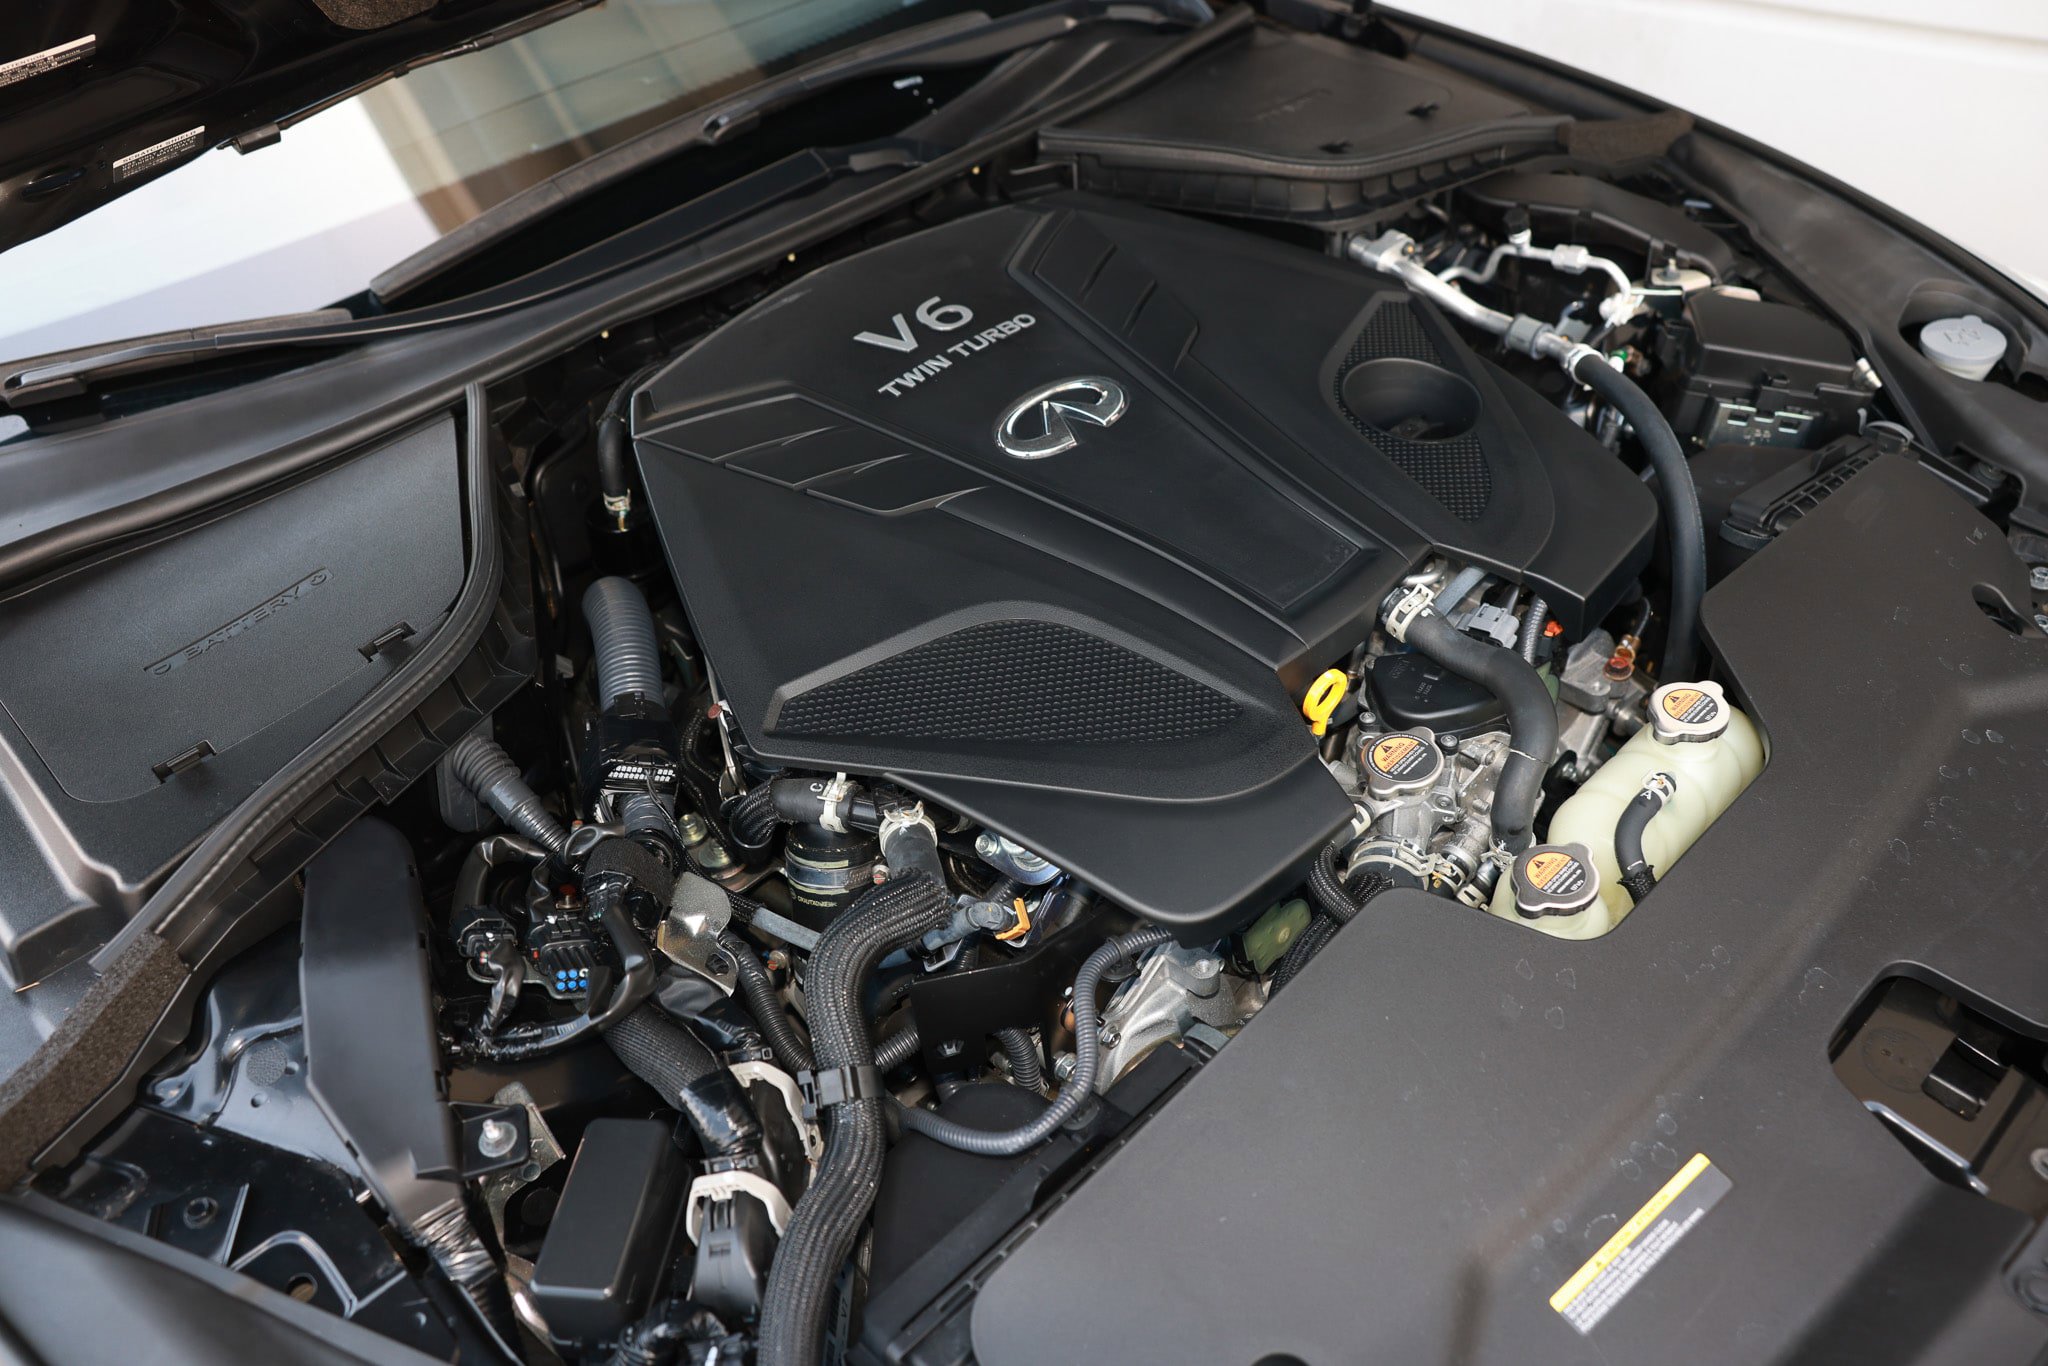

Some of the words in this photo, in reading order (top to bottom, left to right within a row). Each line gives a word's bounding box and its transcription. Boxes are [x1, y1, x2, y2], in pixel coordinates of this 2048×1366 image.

[122, 144, 163, 163] SCRATCH
[165, 130, 197, 146] SHIELD
[853, 295, 974, 353] V6
[877, 354, 953, 398] TWIN
[947, 313, 1037, 358] TURBO
[182, 585, 301, 661] BATTERY
[1382, 742, 1405, 762] WARNING
[810, 782, 823, 792] C
[1640, 789, 1652, 801] A
